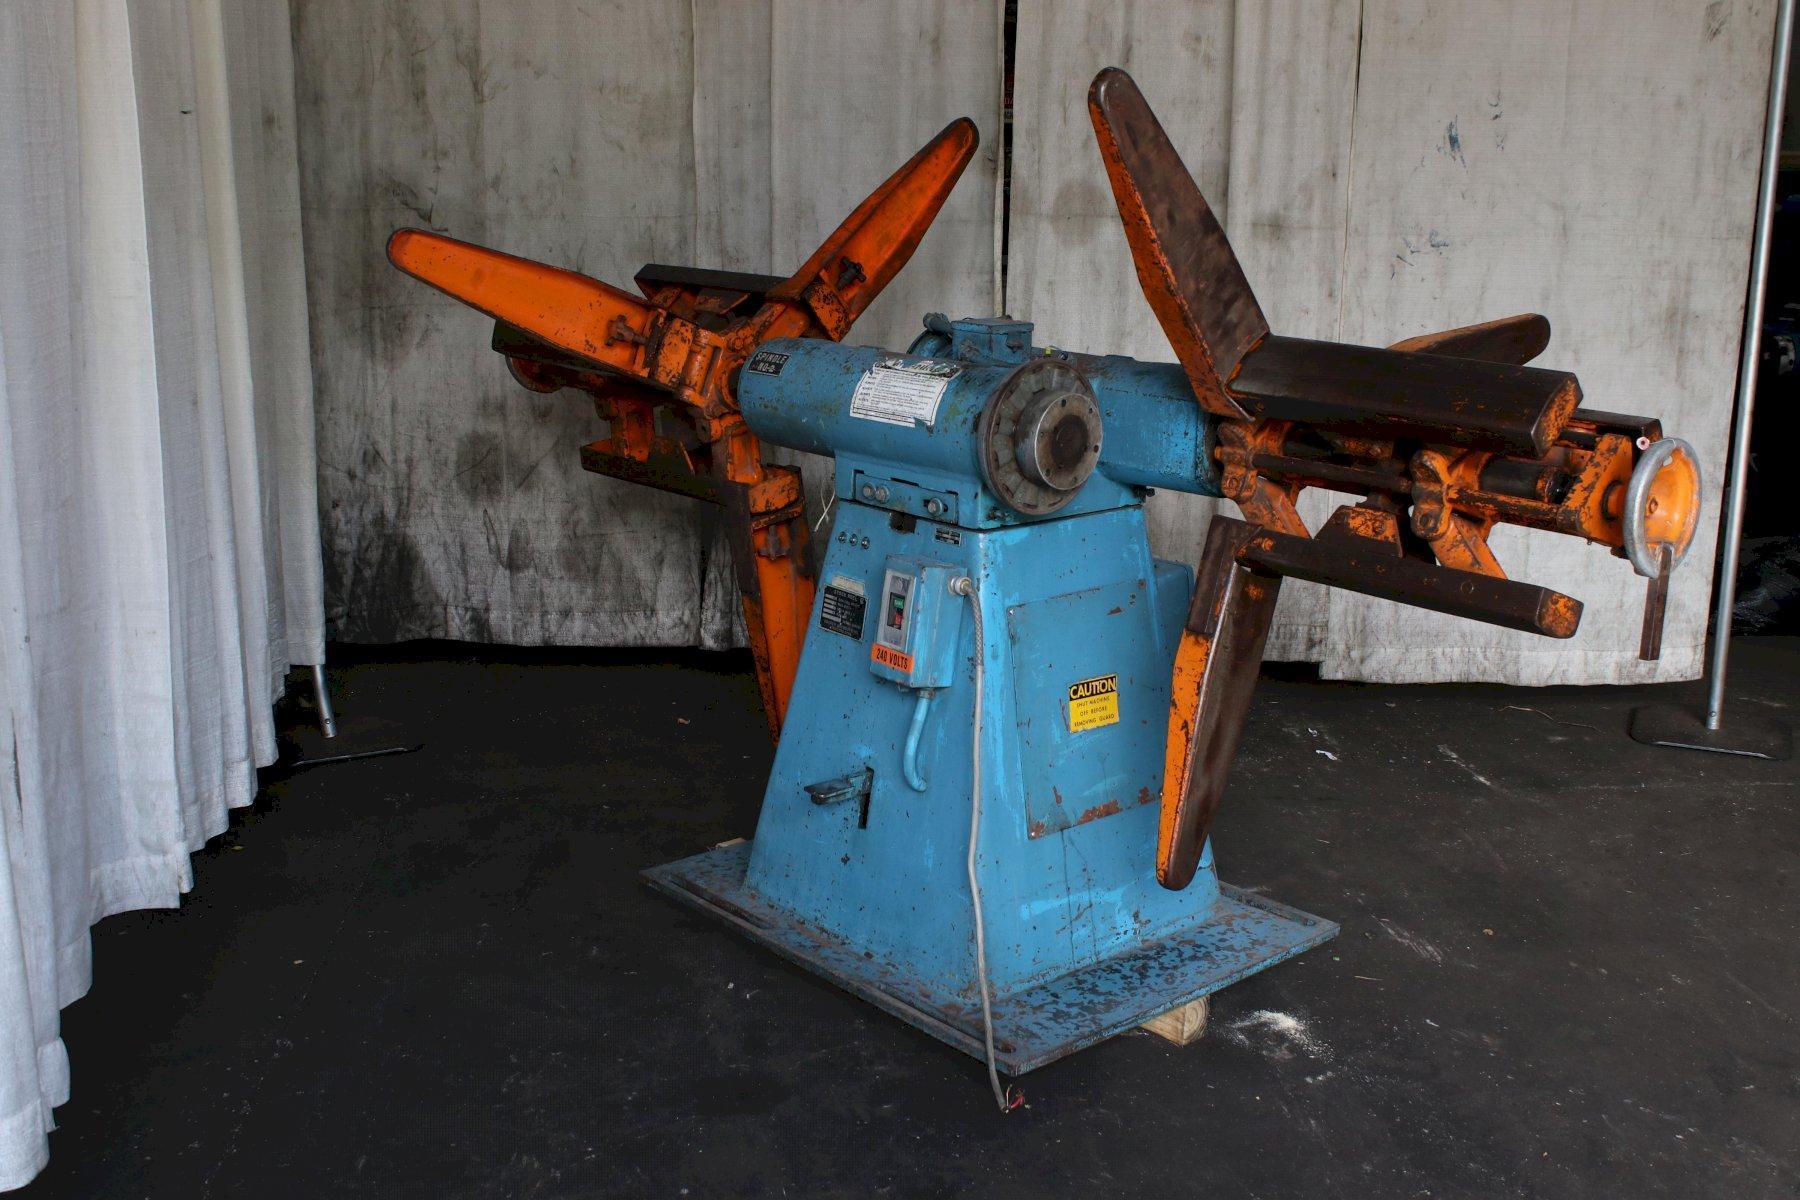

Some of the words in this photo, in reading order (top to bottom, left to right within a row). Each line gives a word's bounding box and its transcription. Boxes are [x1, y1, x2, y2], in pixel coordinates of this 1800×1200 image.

[756, 352, 787, 364] SPINDLE
[876, 648, 888, 662] 240
[890, 652, 908, 670] VOLTS
[1070, 677, 1117, 699] CAUTION
